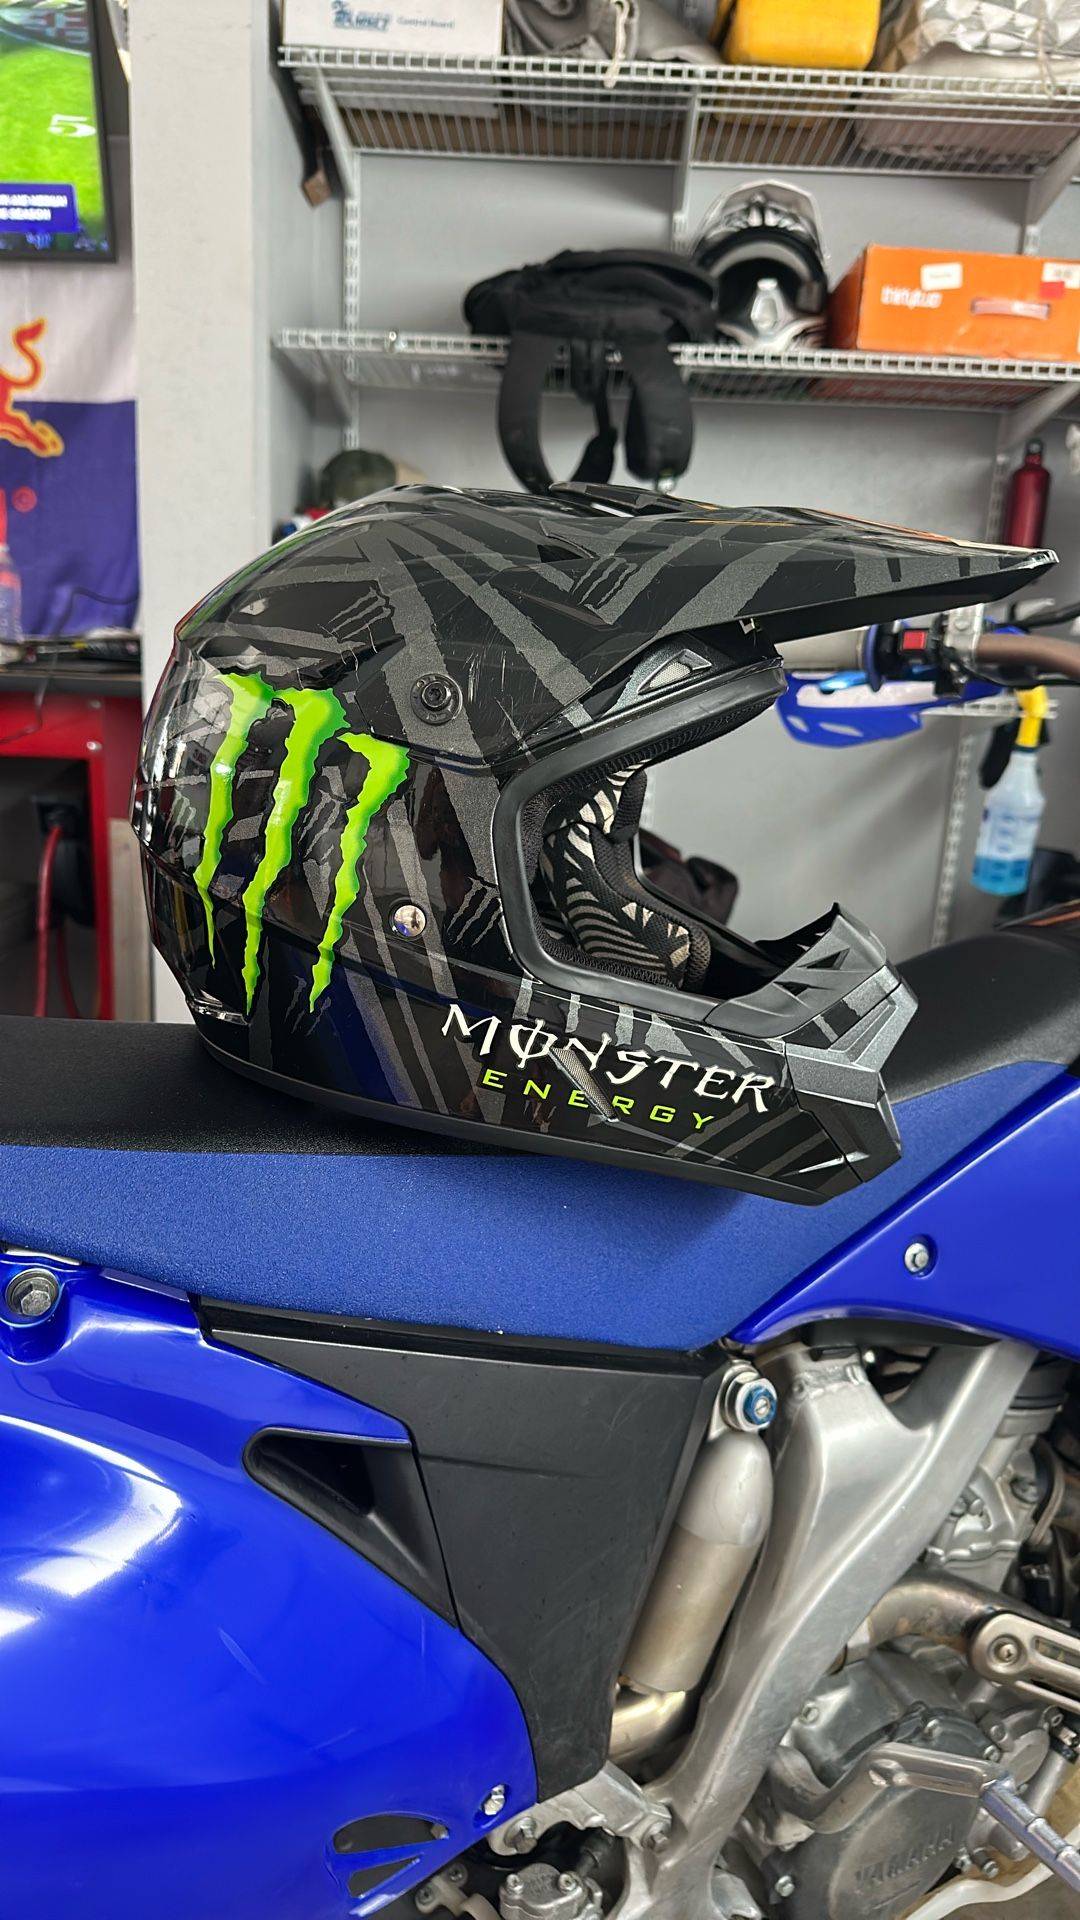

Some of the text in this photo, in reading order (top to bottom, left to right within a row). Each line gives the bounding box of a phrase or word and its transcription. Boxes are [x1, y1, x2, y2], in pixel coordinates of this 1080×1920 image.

[48, 113, 97, 137] 5
[482, 1068, 715, 1130] ENERGY
[853, 1821, 954, 1897] YAMAHA
